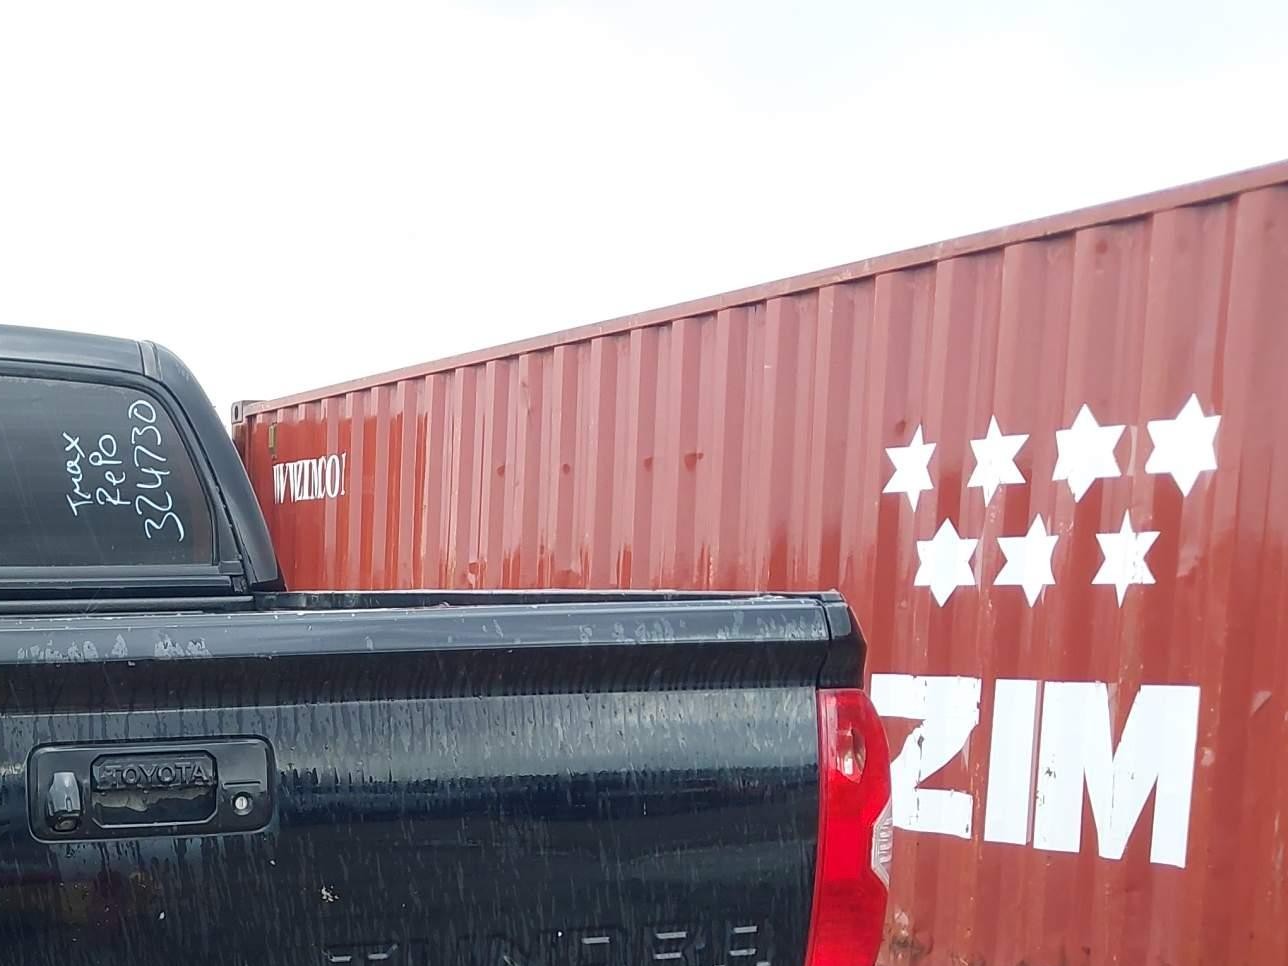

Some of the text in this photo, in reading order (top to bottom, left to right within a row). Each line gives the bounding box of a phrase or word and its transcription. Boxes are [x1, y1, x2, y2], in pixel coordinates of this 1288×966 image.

[128, 399, 185, 542] 324730
[102, 761, 210, 789] TOYOTA
[870, 673, 1201, 869] ZIM
